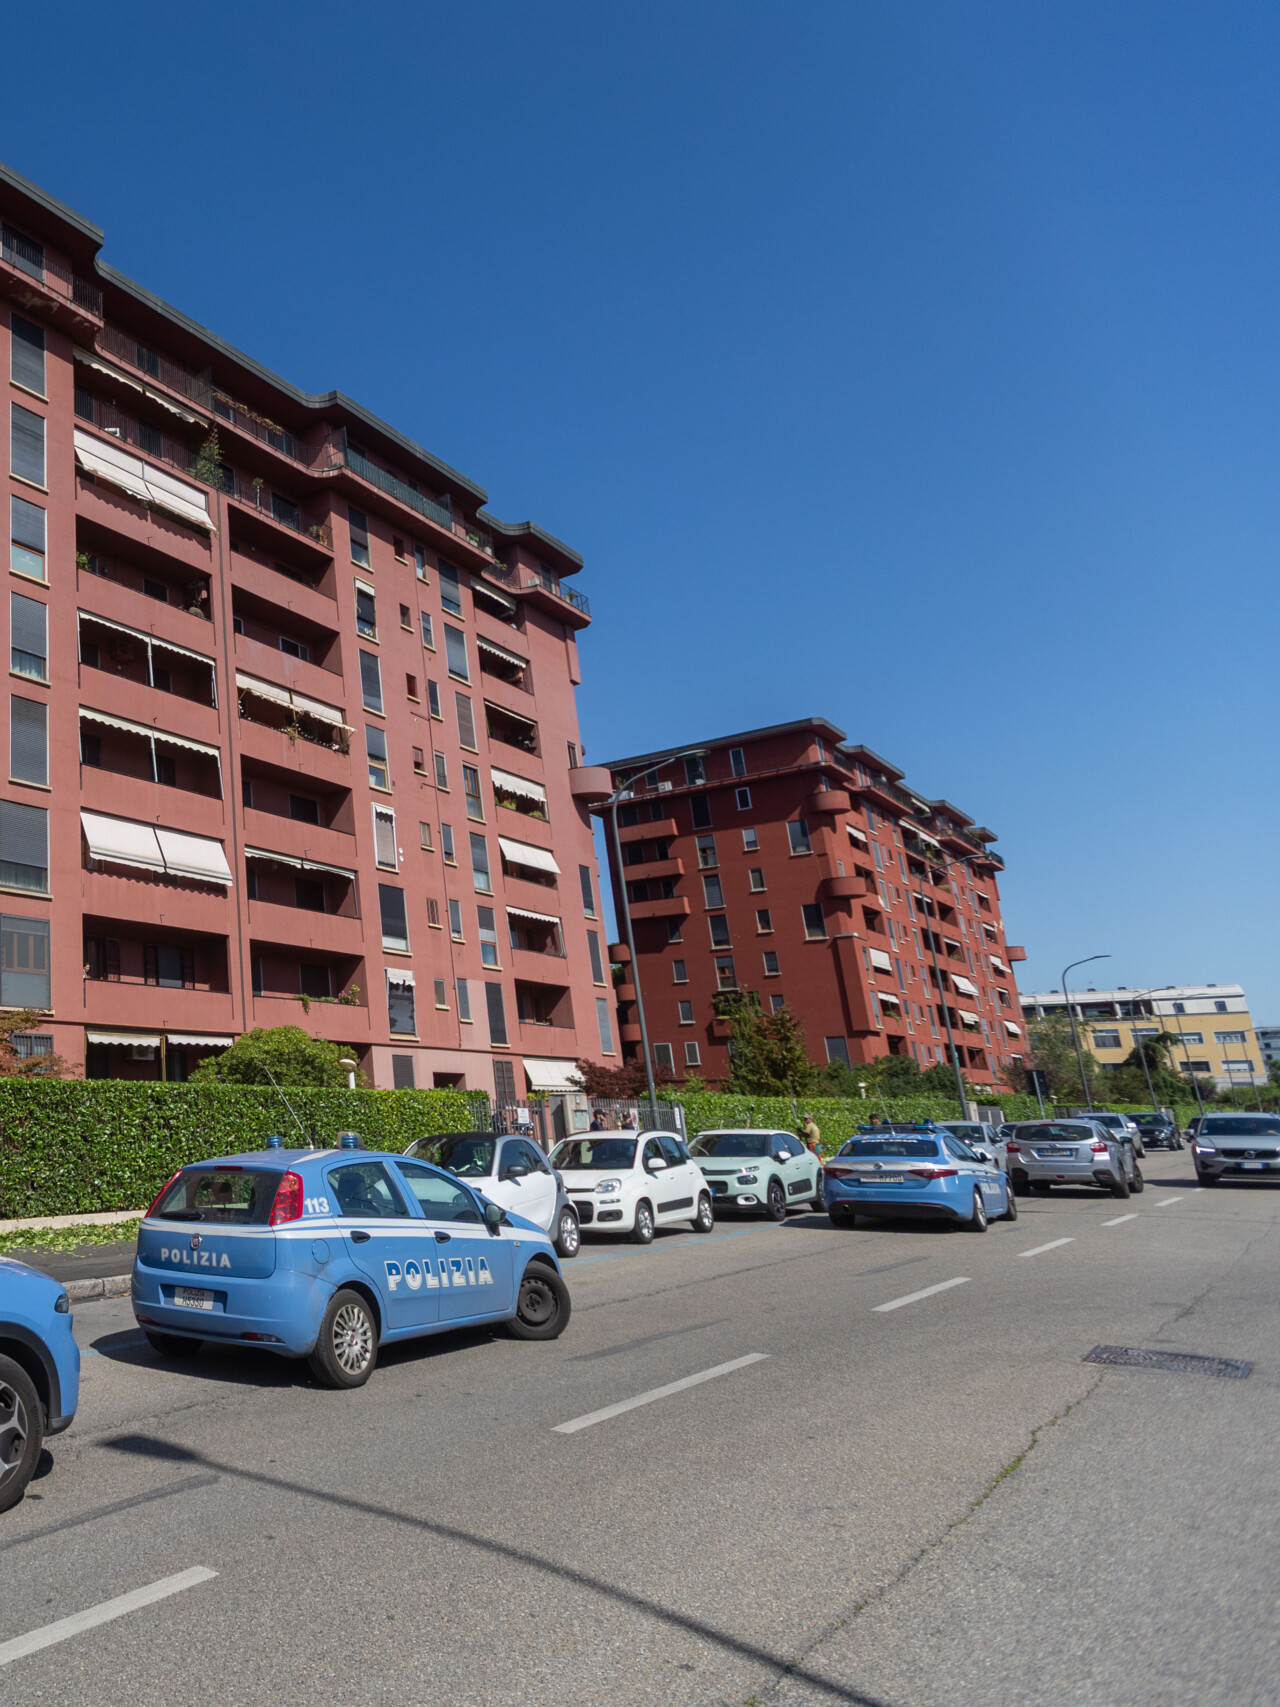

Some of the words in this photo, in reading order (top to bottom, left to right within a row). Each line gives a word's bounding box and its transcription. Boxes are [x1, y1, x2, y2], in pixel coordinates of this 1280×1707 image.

[304, 1197, 330, 1214] 113
[161, 1248, 232, 1268] POLIZIA
[384, 1256, 494, 1291] POLIZIA
[183, 1288, 205, 1297] POLIZIA
